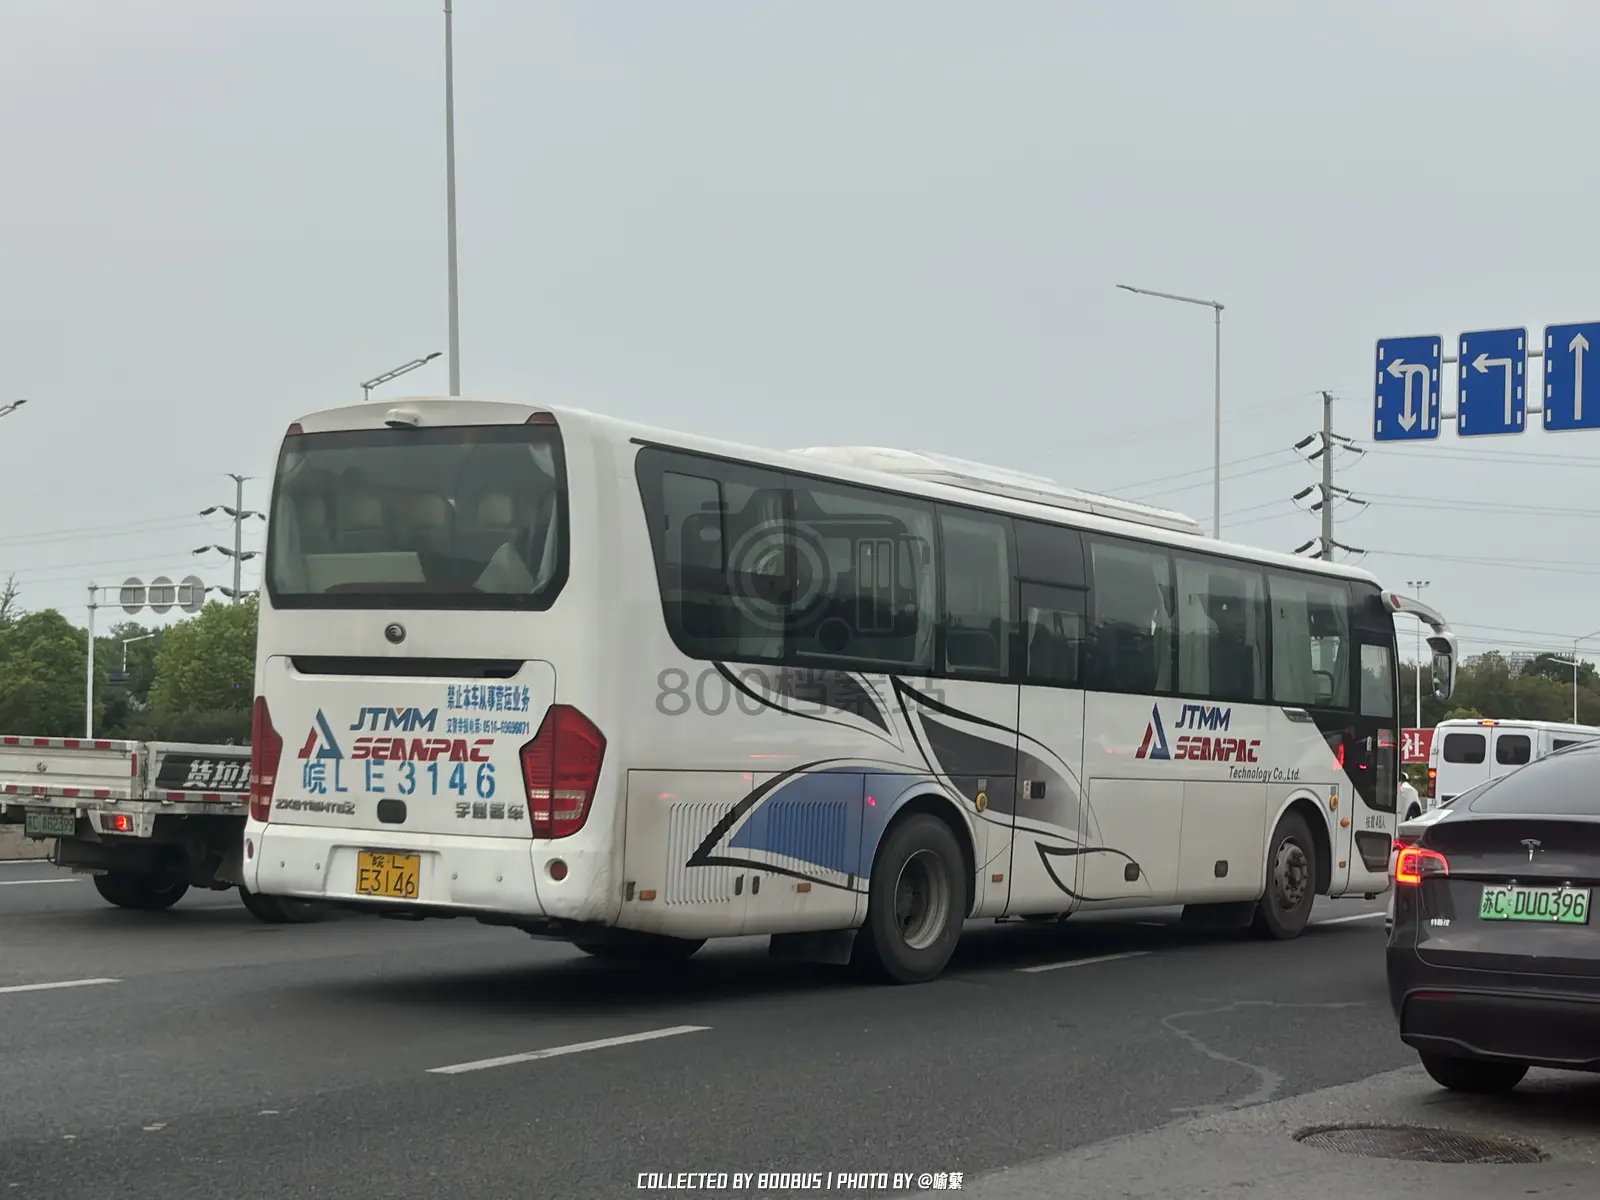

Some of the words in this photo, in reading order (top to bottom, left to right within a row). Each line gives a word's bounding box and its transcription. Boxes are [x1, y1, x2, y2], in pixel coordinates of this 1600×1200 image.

[350, 707, 438, 732] JTMM
[1175, 704, 1231, 731] JTMM
[351, 738, 495, 762] SEANPAC
[1402, 732, 1425, 760] 社
[1229, 766, 1272, 782] Technology
[359, 868, 415, 894] E3146
